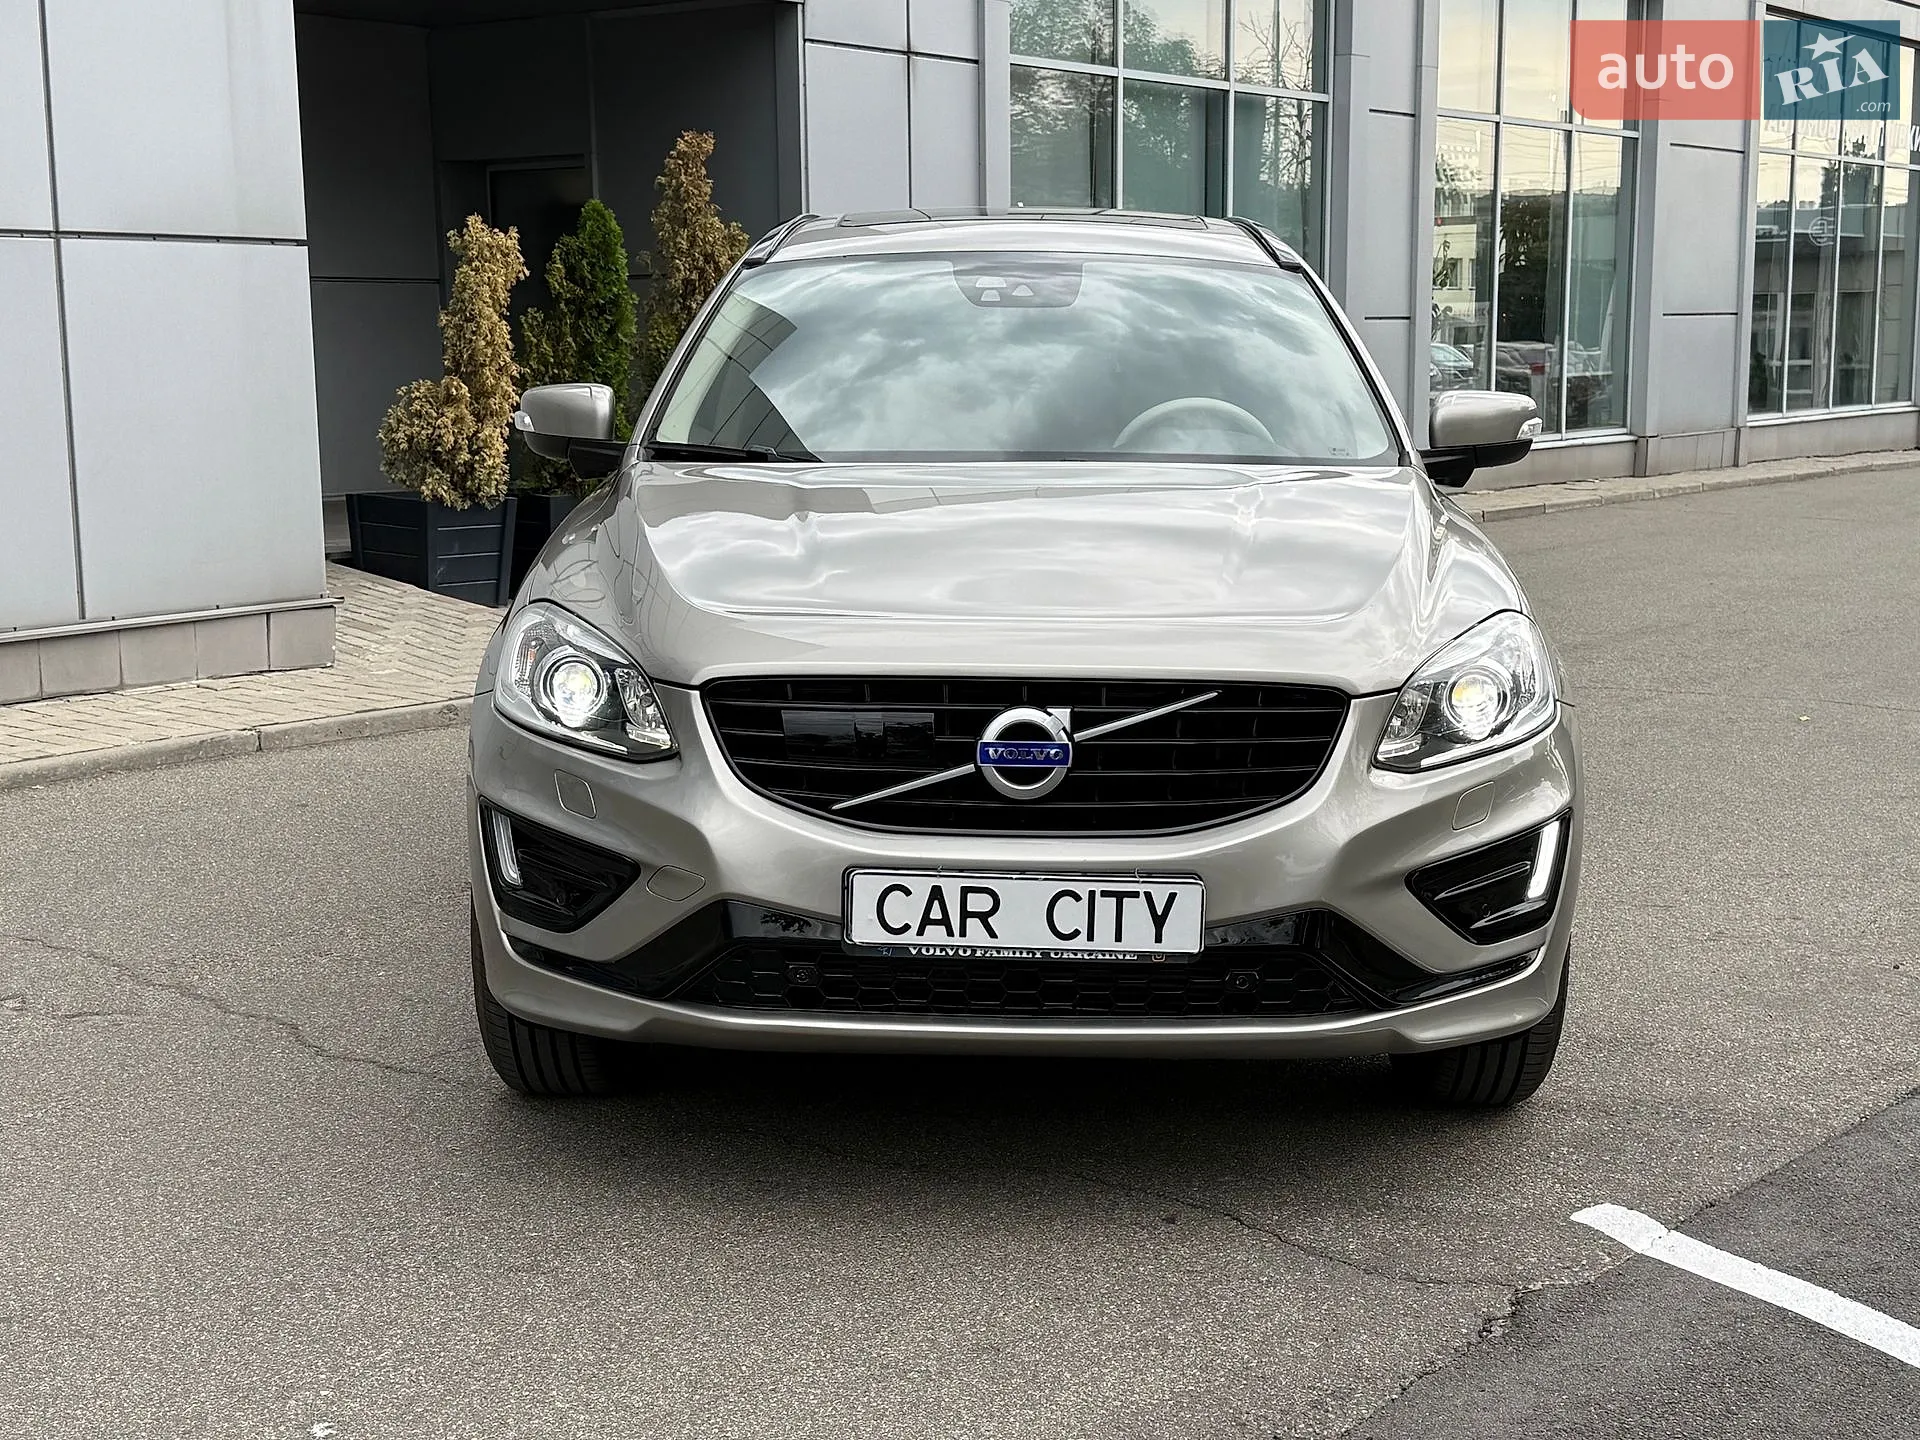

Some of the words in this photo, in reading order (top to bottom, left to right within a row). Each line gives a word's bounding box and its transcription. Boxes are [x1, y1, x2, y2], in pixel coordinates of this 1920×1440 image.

[984, 747, 1064, 760] VOLVO
[876, 883, 1001, 939] CAR
[1045, 889, 1178, 944] CITY
[908, 946, 972, 957] VOLVO
[974, 948, 1043, 958] FAMILY
[1050, 950, 1138, 960] UKRAINE
